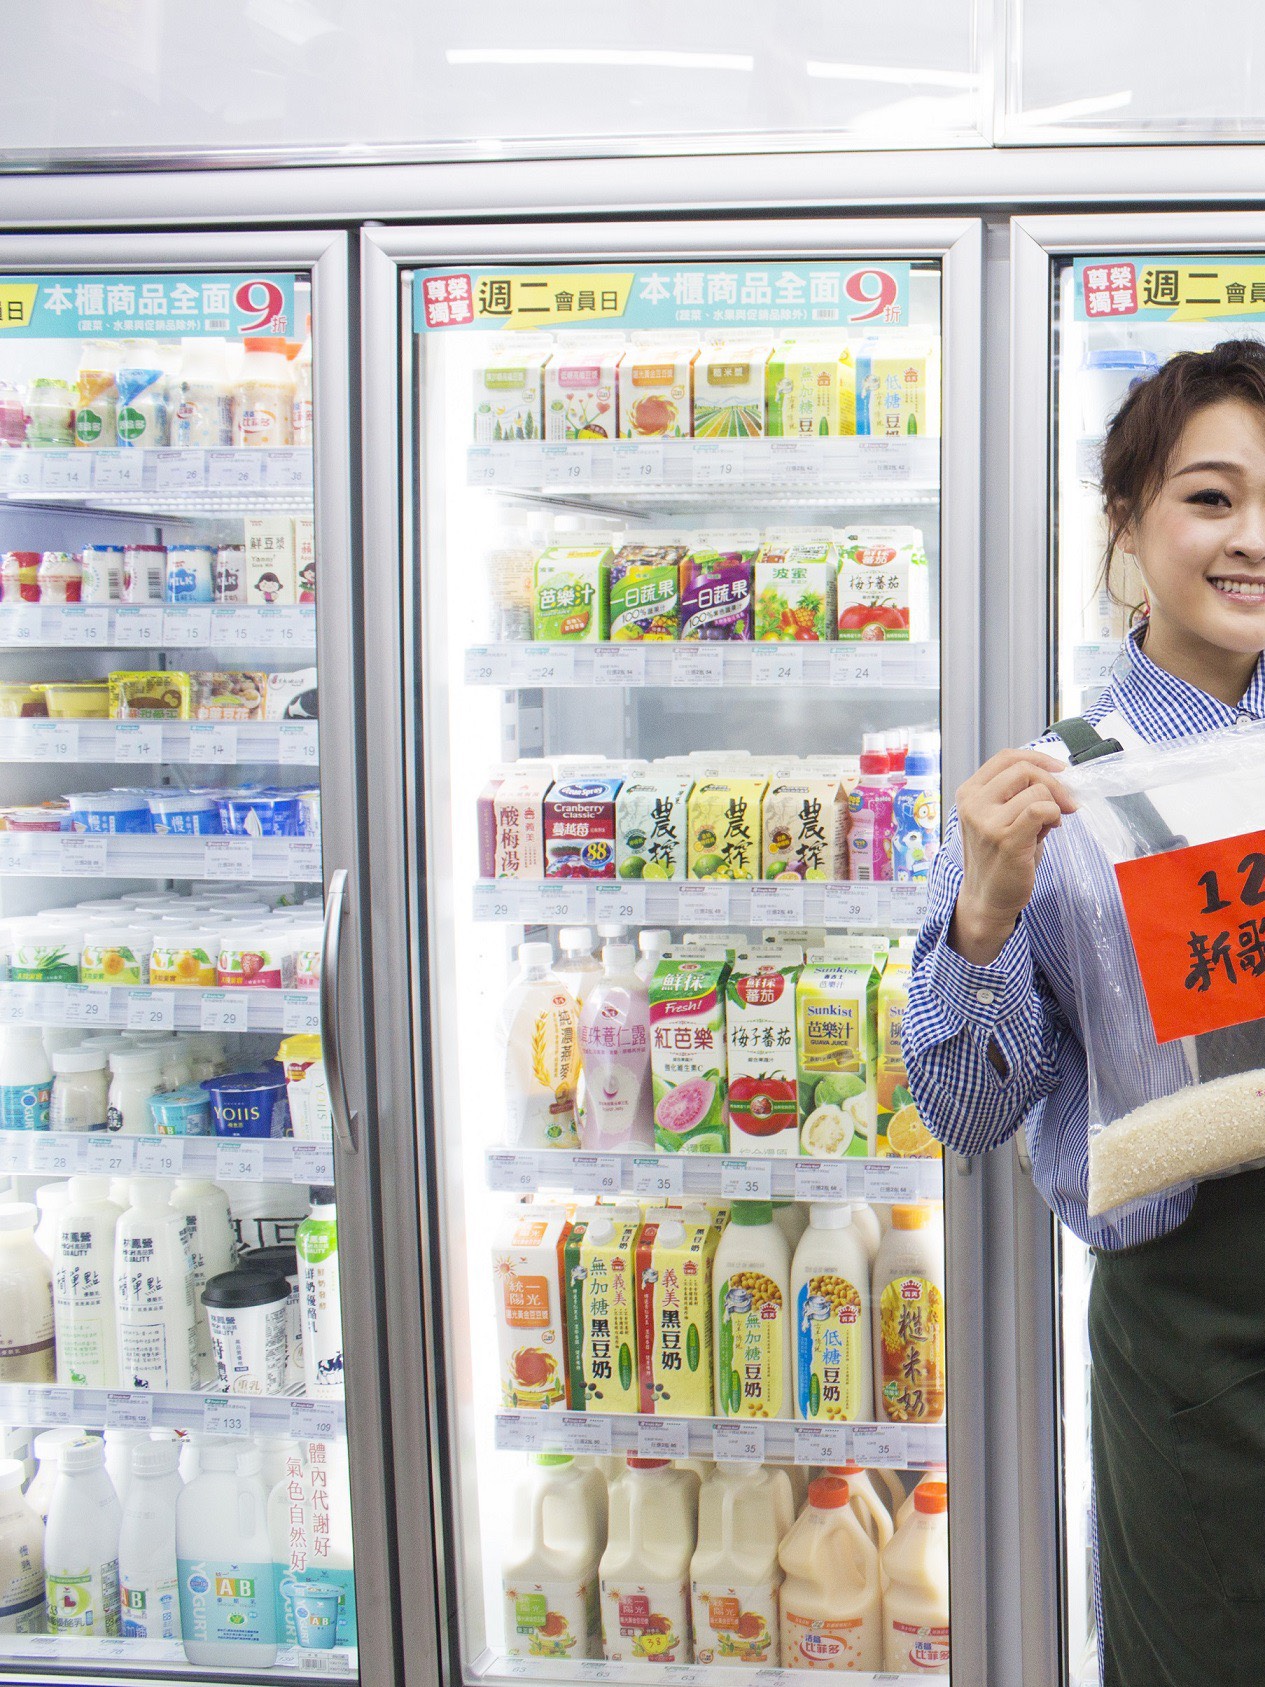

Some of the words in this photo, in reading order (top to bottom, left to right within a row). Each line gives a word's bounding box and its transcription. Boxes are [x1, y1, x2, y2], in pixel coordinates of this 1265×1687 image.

[640, 271, 840, 306] 本櫃商品全面
[43, 283, 231, 316] 本櫃商品全面
[250, 536, 285, 550] 鮮豆漿
[772, 567, 808, 580] 波蜜
[849, 574, 900, 591] 梅子蕃茄
[540, 585, 594, 609] 芭樂汁
[611, 579, 674, 608] 一日蔬果
[682, 580, 748, 608] 一日蔬果
[85, 628, 96, 638] 15
[139, 628, 150, 638] 15
[187, 629, 198, 638] 15
[236, 628, 247, 639] 15
[281, 629, 293, 639] 15
[541, 667, 554, 677] 24
[778, 667, 791, 677] 24
[855, 668, 869, 678] 24
[55, 743, 67, 754] 19
[554, 804, 604, 813] Cranberry
[553, 823, 589, 836] 蔓越莓
[500, 806, 519, 871] 酸梅湯
[588, 842, 606, 861] 88
[494, 904, 508, 915] 29
[620, 905, 633, 916] 29
[745, 978, 776, 989] 鮮採
[745, 989, 775, 1003] 蕃茄
[85, 1004, 98, 1014] 29
[665, 1001, 702, 1013] Fresh!
[807, 1004, 853, 1018] Sunkist
[150, 1012, 163, 1022] 29
[223, 1013, 236, 1024] 29
[807, 1020, 853, 1040] 芭樂汁
[654, 1027, 714, 1051] 紅芭樂
[731, 1026, 791, 1048] 梅子蕃茄
[54, 1157, 66, 1168] 28
[109, 1158, 122, 1168] 27
[160, 1158, 172, 1168] 19
[239, 1163, 251, 1173] 34
[657, 1179, 671, 1189] 35
[745, 1181, 759, 1192] 35
[611, 1273, 627, 1306] 義美
[589, 1256, 612, 1380] 無加糖黑豆奶
[661, 1268, 682, 1371] 義美黑豆奶
[744, 1313, 762, 1399] 無加糖豆奶
[897, 1304, 927, 1419] 糙米奶
[822, 1329, 842, 1402] 低糖豆奶
[224, 1418, 242, 1429] 133
[745, 1444, 756, 1453] 35
[821, 1447, 832, 1456] 35
[878, 1445, 889, 1454] 35
[308, 1442, 331, 1558] 體內代謝好
[285, 1456, 308, 1573] 氣色自然好
[215, 1577, 255, 1598] AB
[805, 1642, 840, 1654] 比菲多
